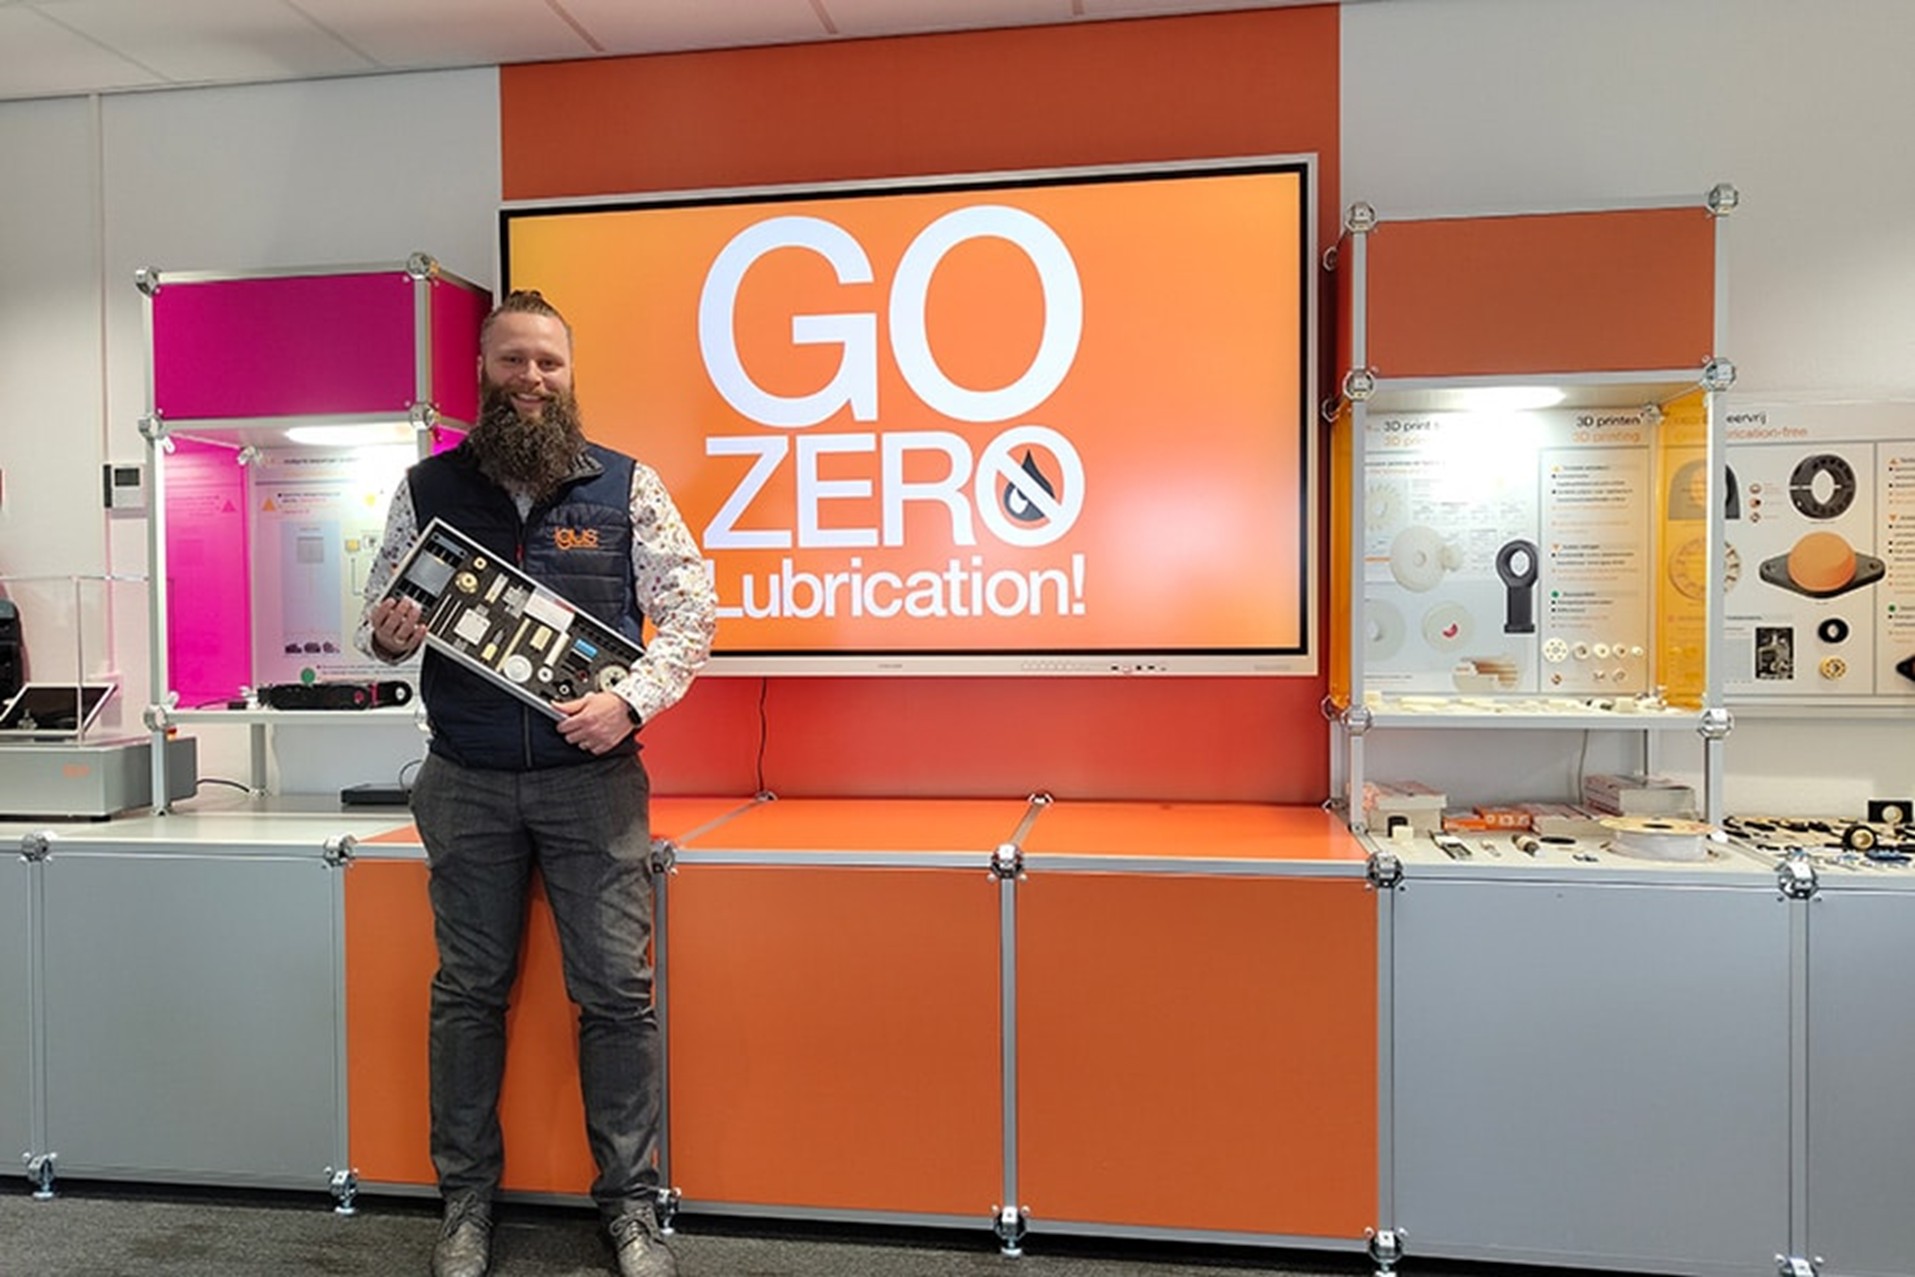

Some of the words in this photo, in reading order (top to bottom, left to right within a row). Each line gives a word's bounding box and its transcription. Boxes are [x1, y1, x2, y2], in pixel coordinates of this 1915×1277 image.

[699, 205, 1083, 428] GO
[1576, 416, 1594, 428] 3D
[1726, 412, 1767, 425] eervrij
[703, 425, 1085, 549] ZERO
[554, 525, 599, 550] igus
[706, 554, 1086, 618] Lubrication!
